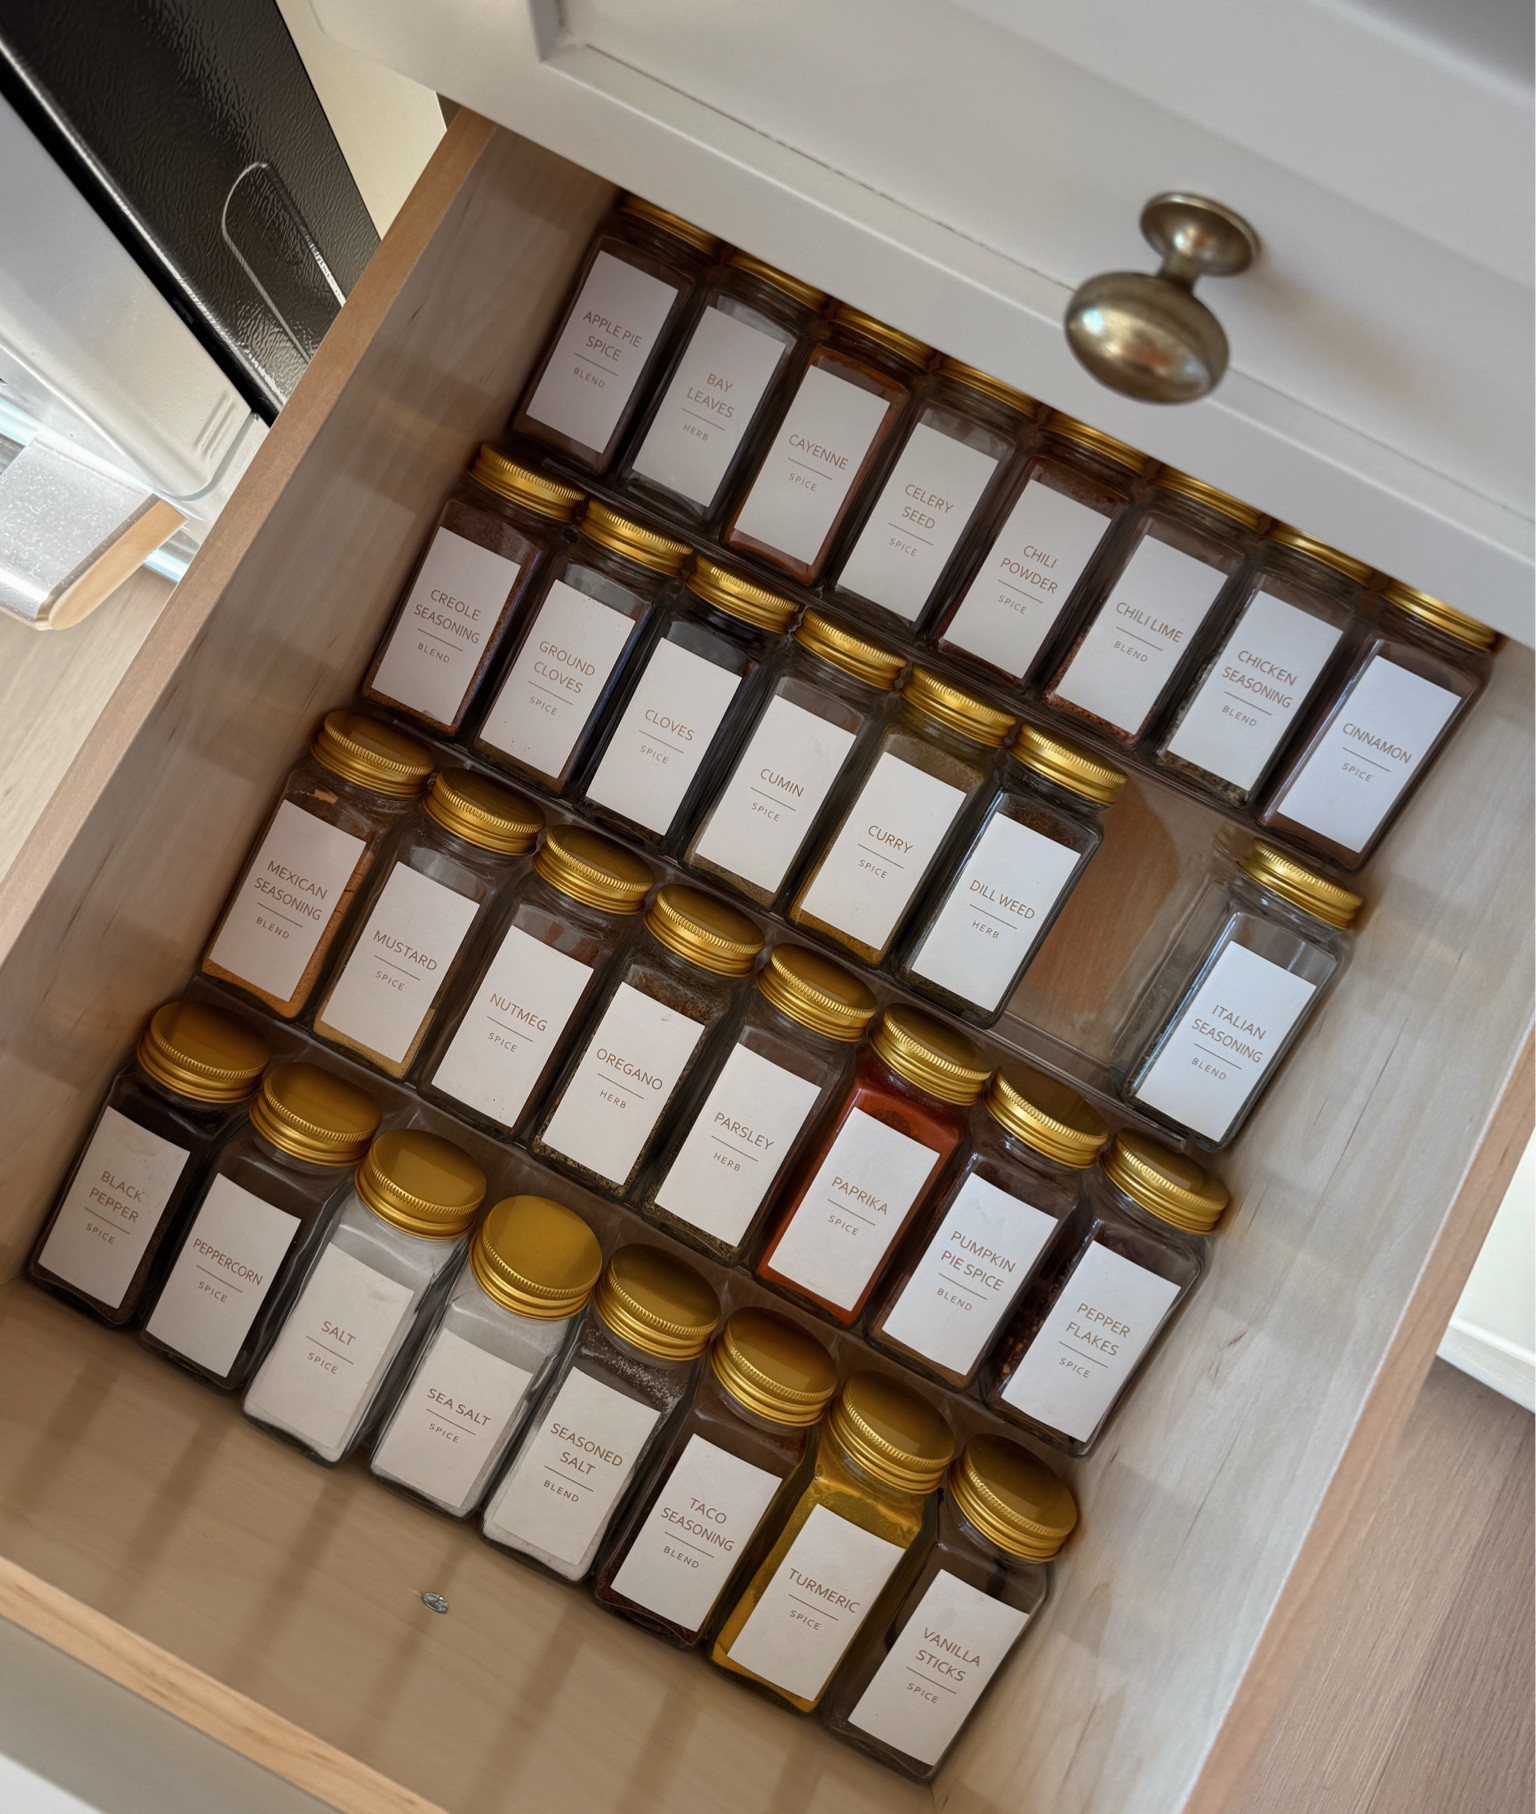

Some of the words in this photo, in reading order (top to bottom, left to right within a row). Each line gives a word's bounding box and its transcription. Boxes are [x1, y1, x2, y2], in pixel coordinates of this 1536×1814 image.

[582, 311, 623, 338] APPLE
[621, 329, 643, 349] PIE
[585, 335, 622, 362] SPICE
[573, 367, 606, 388] BLEND
[706, 373, 734, 393] BAY
[687, 387, 735, 419] LEAVES
[683, 424, 709, 442] HERB
[789, 434, 850, 471] CAYENNE
[789, 473, 818, 492] SPICE
[904, 484, 955, 514] CELERY
[901, 506, 936, 530] SEED
[889, 537, 918, 558] SPICE
[1023, 545, 1059, 570] CHILI
[1000, 557, 1059, 595] POWDER
[430, 589, 482, 622] CREOLE
[998, 595, 1028, 615] SPICE
[413, 603, 481, 645] SEASONING
[1115, 602, 1152, 627] CHILI
[1149, 618, 1185, 644] LIME
[417, 642, 451, 664] BLEND
[539, 640, 596, 677] GROUND
[1113, 640, 1149, 663] BLEND
[533, 661, 584, 694] CLOVES
[1237, 650, 1298, 687] CHICKEN
[1221, 666, 1294, 709] SEASONING
[529, 696, 558, 717] SPICE
[1222, 705, 1258, 728] BLEND
[645, 709, 696, 742] CLOVES
[640, 745, 670, 765] SPICE
[1342, 722, 1414, 765] CINNAMON
[760, 768, 805, 798] CUMIN
[1342, 762, 1374, 783] SPICE
[751, 802, 781, 822] SPICE
[868, 825, 914, 855] CURRY
[266, 860, 329, 901] MEXICAN
[858, 859, 889, 880] SPICE
[254, 877, 323, 921] SEASONING
[969, 879, 996, 903] DILL
[998, 893, 1036, 920] WEED
[256, 916, 290, 940] BLEND
[971, 920, 1001, 940] HERB
[373, 930, 439, 972] MUSTARD
[375, 970, 406, 992] SPICE
[489, 992, 549, 1033] NUTMEG
[1211, 1004, 1268, 1041] ITALIAN
[487, 1032, 519, 1054] SPICE
[1191, 1018, 1264, 1064] SEASONING
[596, 1048, 664, 1091] OREGANO
[1191, 1057, 1227, 1081] BLEND
[599, 1089, 628, 1110] HERB
[713, 1111, 776, 1151] PARSLEY
[713, 1151, 742, 1172] HERB
[101, 1170, 146, 1204] BLACK
[831, 1176, 888, 1217] PAPRIKA
[89, 1187, 140, 1224] PEPPER
[86, 1223, 115, 1245] SPICE
[828, 1214, 860, 1237] SPICE
[192, 1238, 264, 1287] PEPPERCORN
[950, 1230, 1017, 1274] PUMPKIN
[940, 1249, 966, 1272] PIE
[963, 1263, 1005, 1292] SPICE
[198, 1281, 228, 1304] SPICE
[936, 1287, 973, 1311] BLEND
[321, 1320, 357, 1347] SALT
[1076, 1302, 1131, 1339] PEPPER
[1065, 1321, 1120, 1357] FLAKES
[307, 1352, 339, 1375] SPICE
[1059, 1357, 1091, 1379] SPICE
[426, 1388, 454, 1411] SEA
[455, 1403, 492, 1427] SALT
[428, 1423, 460, 1444] SPICE
[550, 1422, 625, 1468] SEASONED
[559, 1451, 597, 1476] SALT
[543, 1479, 580, 1503] BLEND
[690, 1497, 728, 1525] TACO
[660, 1507, 736, 1552] SEASONING
[663, 1545, 700, 1569] BLEND
[789, 1567, 861, 1614] TURMERIC
[789, 1609, 822, 1632] SPICE
[924, 1627, 981, 1668] VANILLA
[915, 1649, 967, 1683] STICKS
[906, 1682, 940, 1705] SPICE
